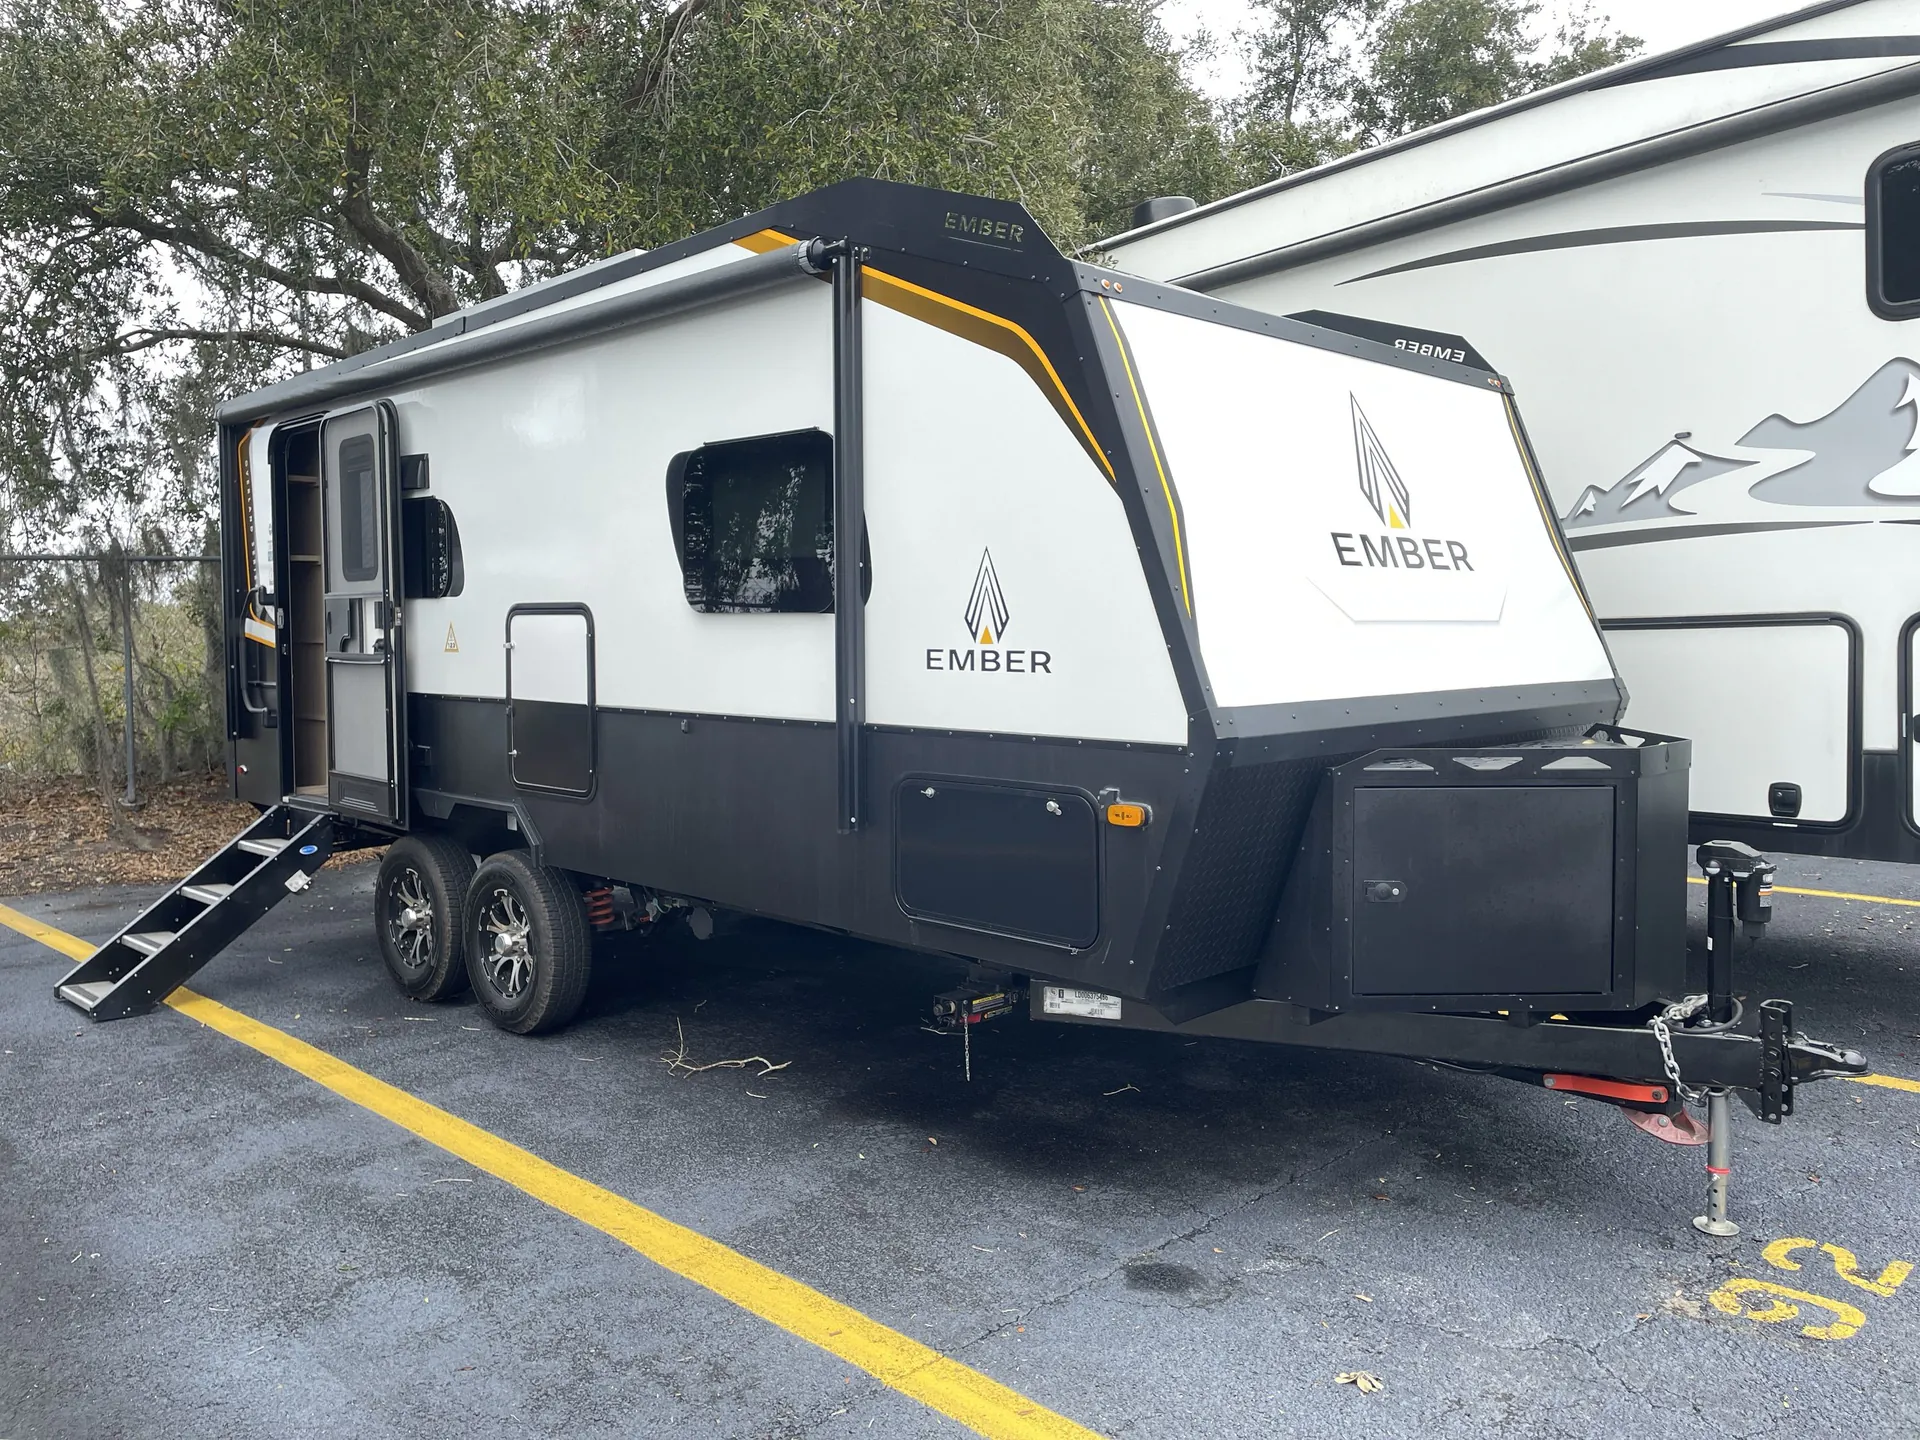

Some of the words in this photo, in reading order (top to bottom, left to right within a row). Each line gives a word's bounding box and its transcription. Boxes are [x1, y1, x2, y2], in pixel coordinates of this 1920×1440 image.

[944, 211, 1024, 243] EMBER
[1330, 532, 1475, 571] EMBER
[926, 648, 1052, 674] EMBER
